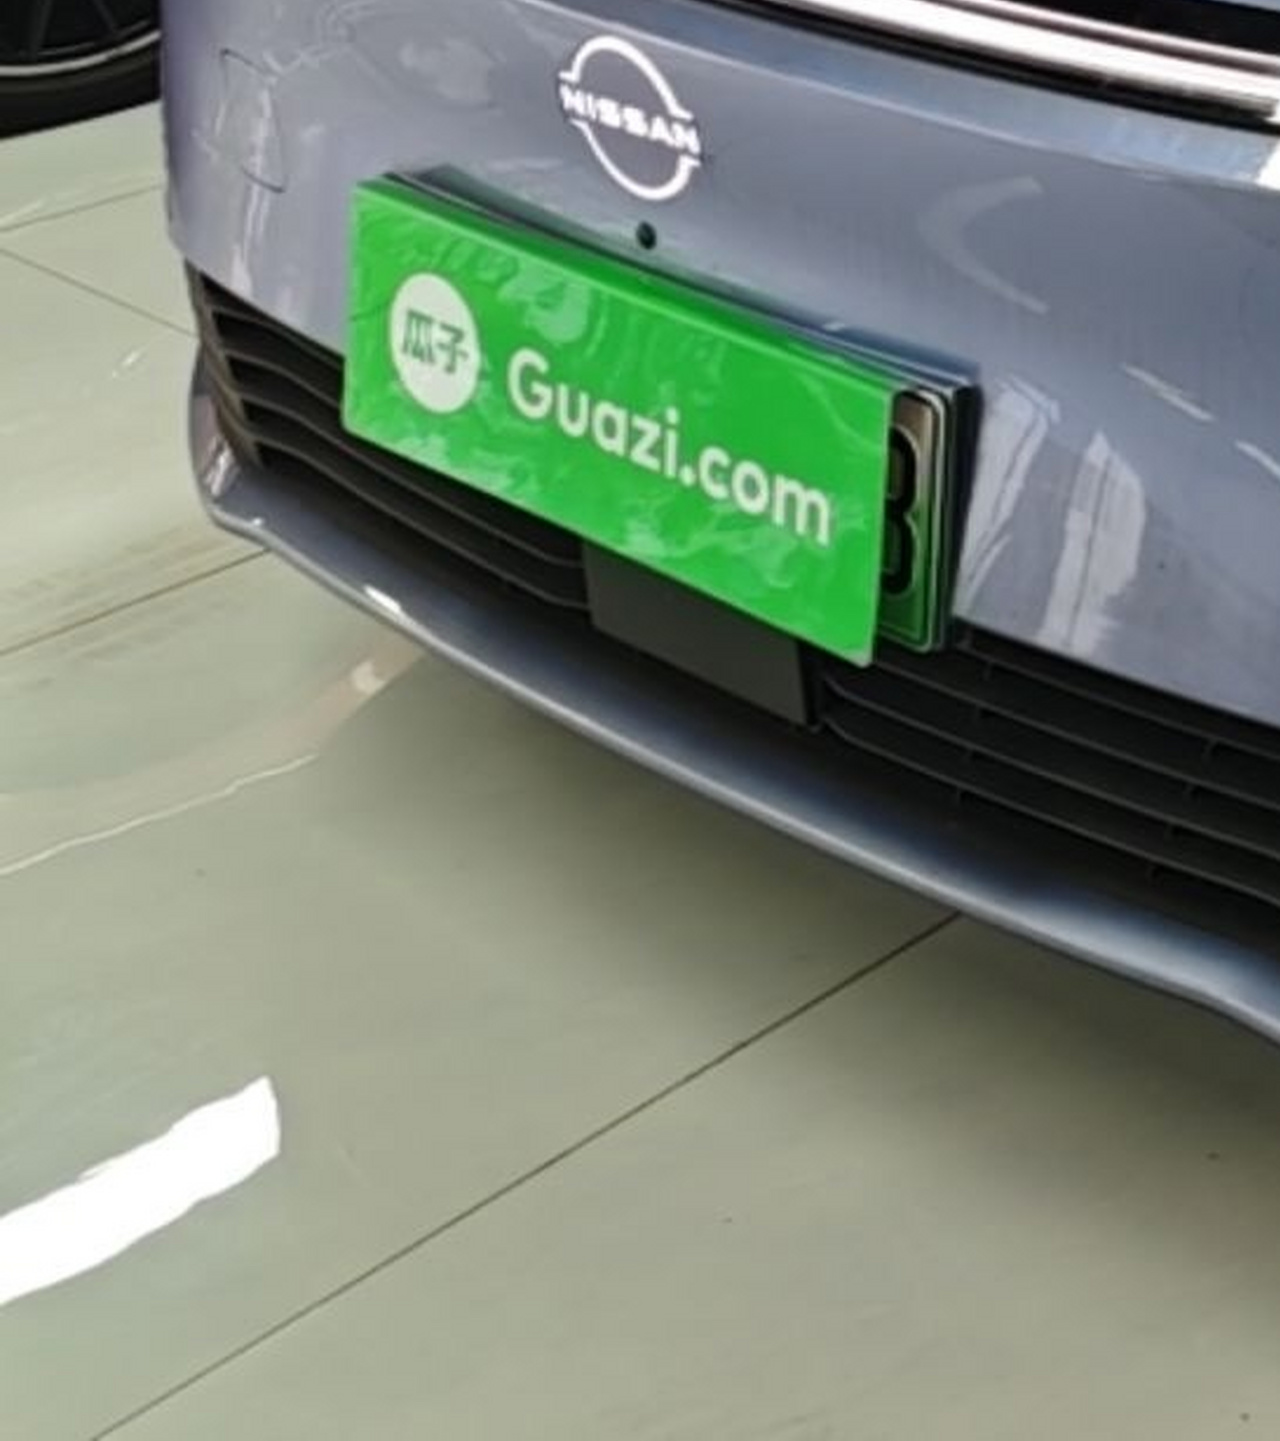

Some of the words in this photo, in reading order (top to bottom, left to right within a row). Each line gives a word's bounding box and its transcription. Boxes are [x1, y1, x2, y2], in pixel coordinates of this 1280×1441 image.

[560, 84, 700, 155] NISSAN
[403, 307, 469, 375] 瓜子
[508, 347, 834, 547] Guazi.com
